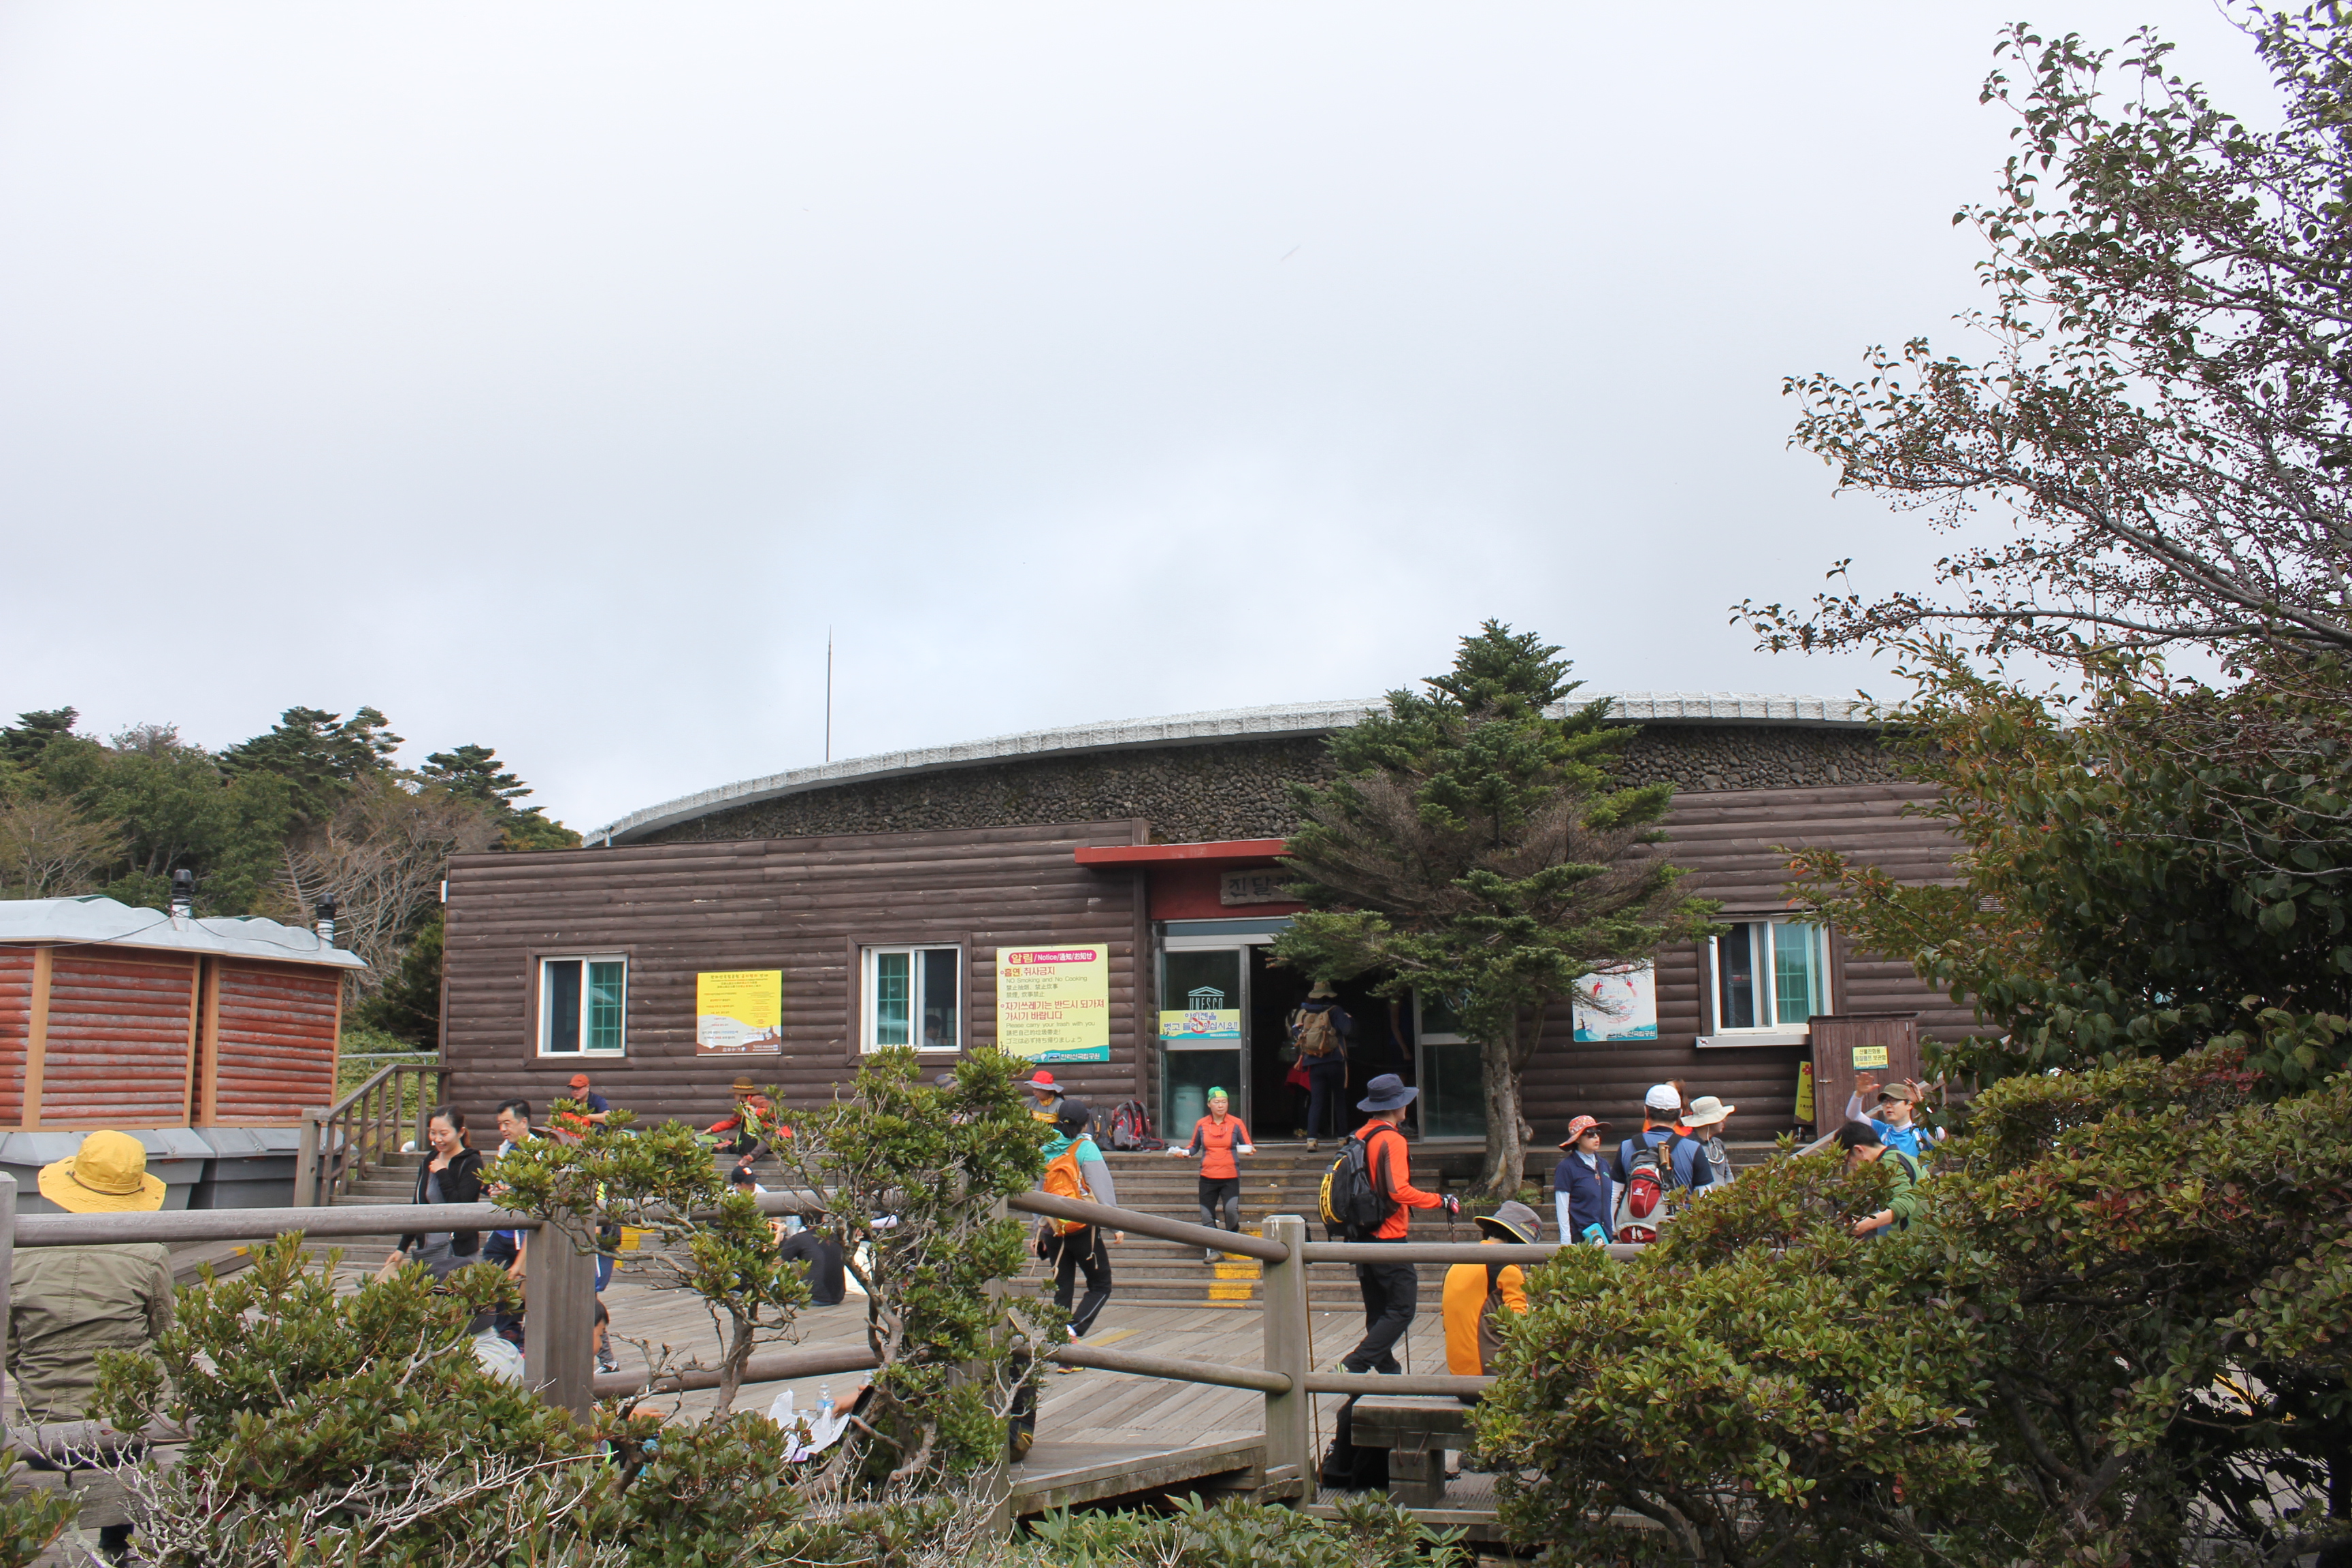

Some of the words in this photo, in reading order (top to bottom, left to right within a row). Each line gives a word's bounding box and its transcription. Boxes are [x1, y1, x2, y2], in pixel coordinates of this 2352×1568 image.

[1228, 875, 1316, 898] 진달래
[1024, 966, 1055, 976] 취사금지
[1005, 1001, 1052, 1011] 자기쓰레기는
[1054, 1000, 1079, 1009] 반드시
[1080, 999, 1105, 1009] 되가져
[1190, 997, 1223, 1010] UNESCO
[1005, 1012, 1028, 1021] 가시기
[1031, 1011, 1063, 1020] 바랍니다
[1185, 1012, 1217, 1021] 아이젠을
[1164, 1022, 1180, 1031] 벗고
[1183, 1022, 1198, 1031] 들어
